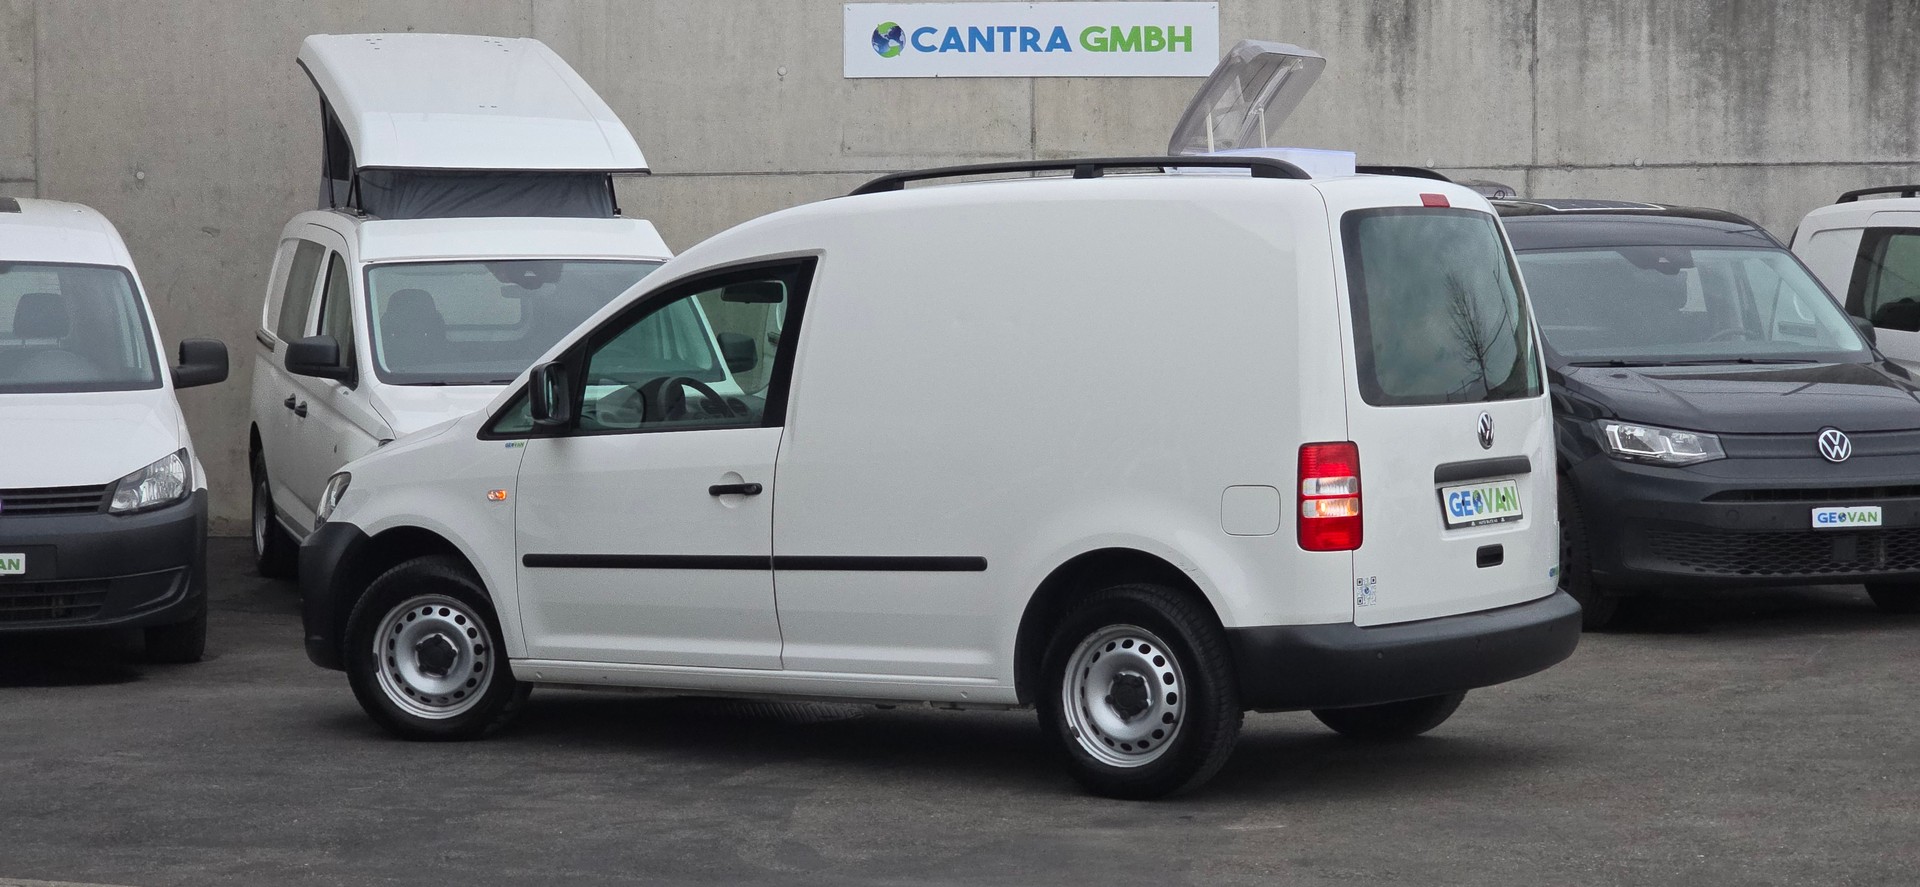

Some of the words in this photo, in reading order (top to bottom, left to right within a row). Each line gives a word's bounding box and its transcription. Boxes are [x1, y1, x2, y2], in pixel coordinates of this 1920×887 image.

[911, 26, 1073, 53] CANTRA
[1079, 25, 1193, 53] GMBH
[1819, 429, 1851, 462] VW
[1449, 486, 1518, 517] GEOVAN
[1817, 511, 1878, 523] GEOVAN
